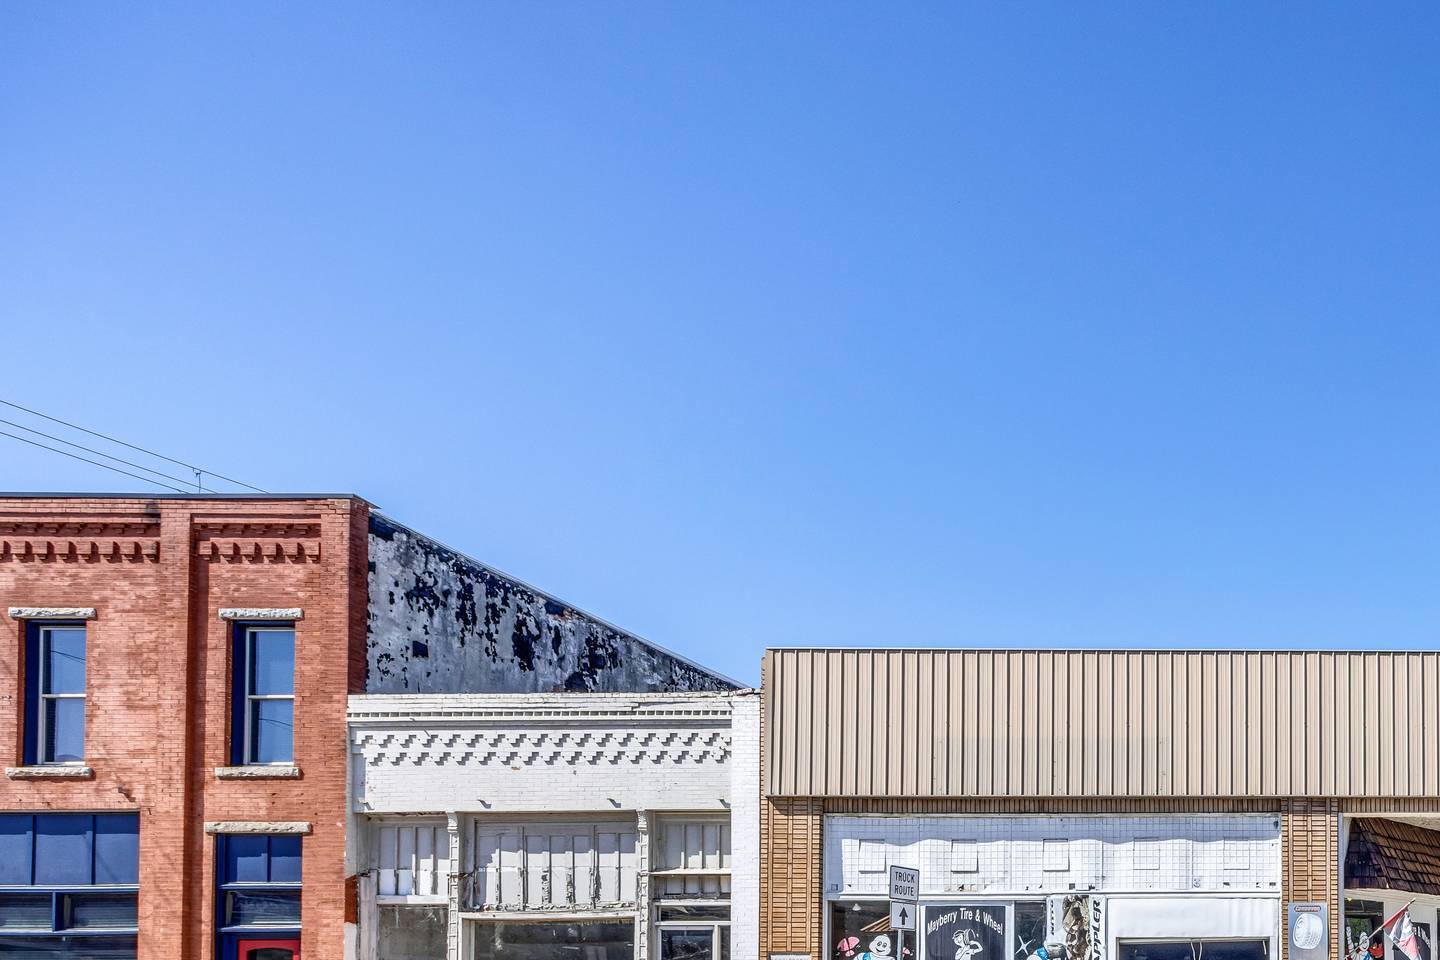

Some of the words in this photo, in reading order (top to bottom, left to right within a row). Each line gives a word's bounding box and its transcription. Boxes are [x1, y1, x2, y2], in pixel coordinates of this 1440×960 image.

[895, 871, 915, 883] TRUCK
[894, 885, 914, 896] ROUTE
[927, 911, 958, 935] Mayberry
[960, 907, 973, 920] Tire
[975, 909, 981, 922] &
[983, 911, 1003, 935] Wheel
